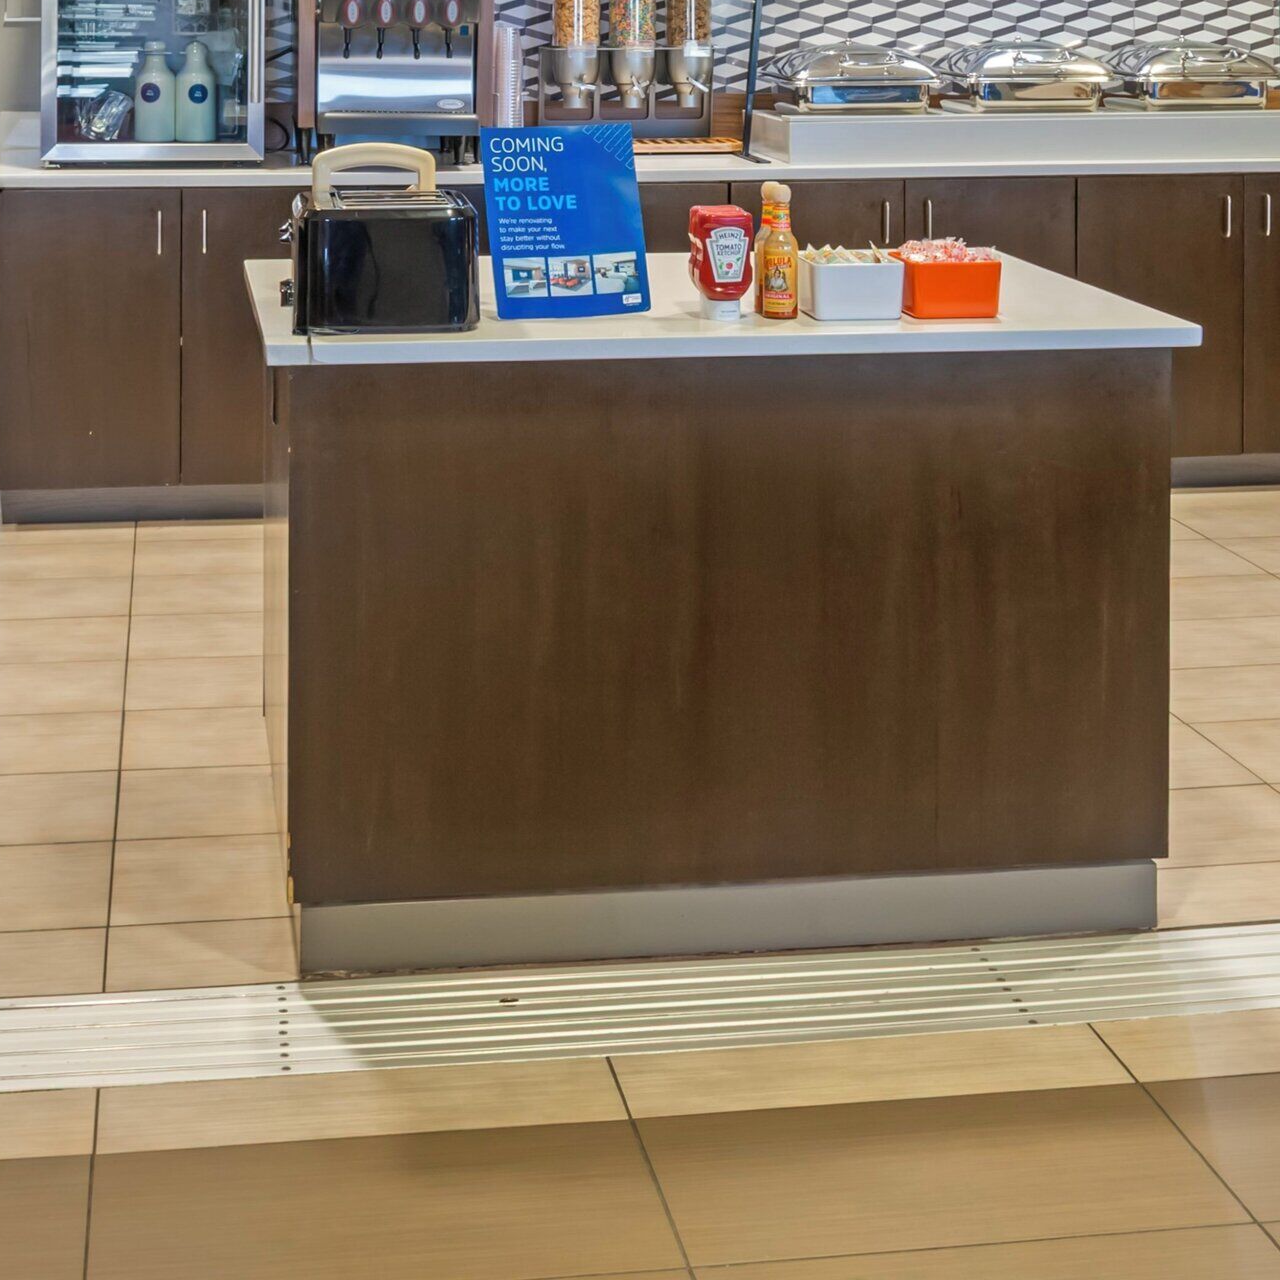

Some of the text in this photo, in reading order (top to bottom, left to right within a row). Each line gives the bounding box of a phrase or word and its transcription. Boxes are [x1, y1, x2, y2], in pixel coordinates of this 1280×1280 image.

[490, 136, 564, 154] COMING
[491, 156, 548, 173] SOON,
[493, 176, 550, 192] MORE
[495, 194, 578, 211] TO LOVE
[518, 217, 553, 225] renovating
[718, 231, 739, 239] HEINZ
